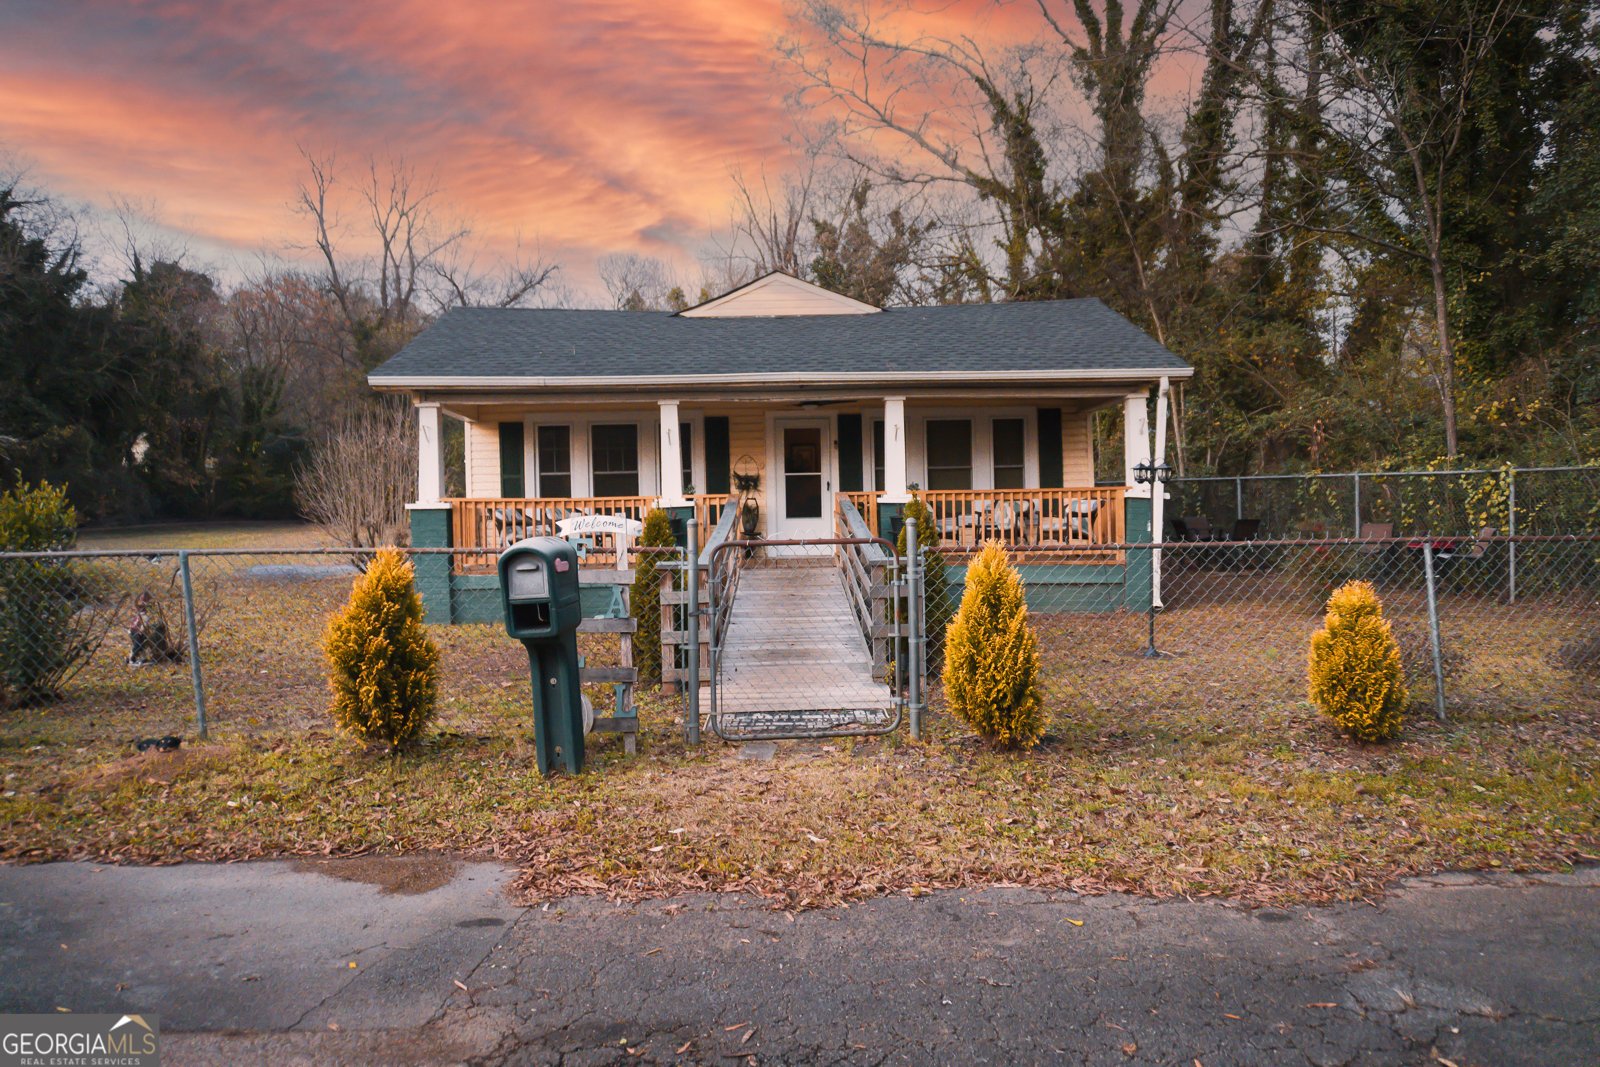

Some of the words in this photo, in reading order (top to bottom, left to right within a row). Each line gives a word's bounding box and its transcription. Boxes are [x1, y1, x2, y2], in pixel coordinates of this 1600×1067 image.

[573, 517, 624, 531] Welcome
[604, 585, 629, 618] A
[613, 684, 637, 718] L
